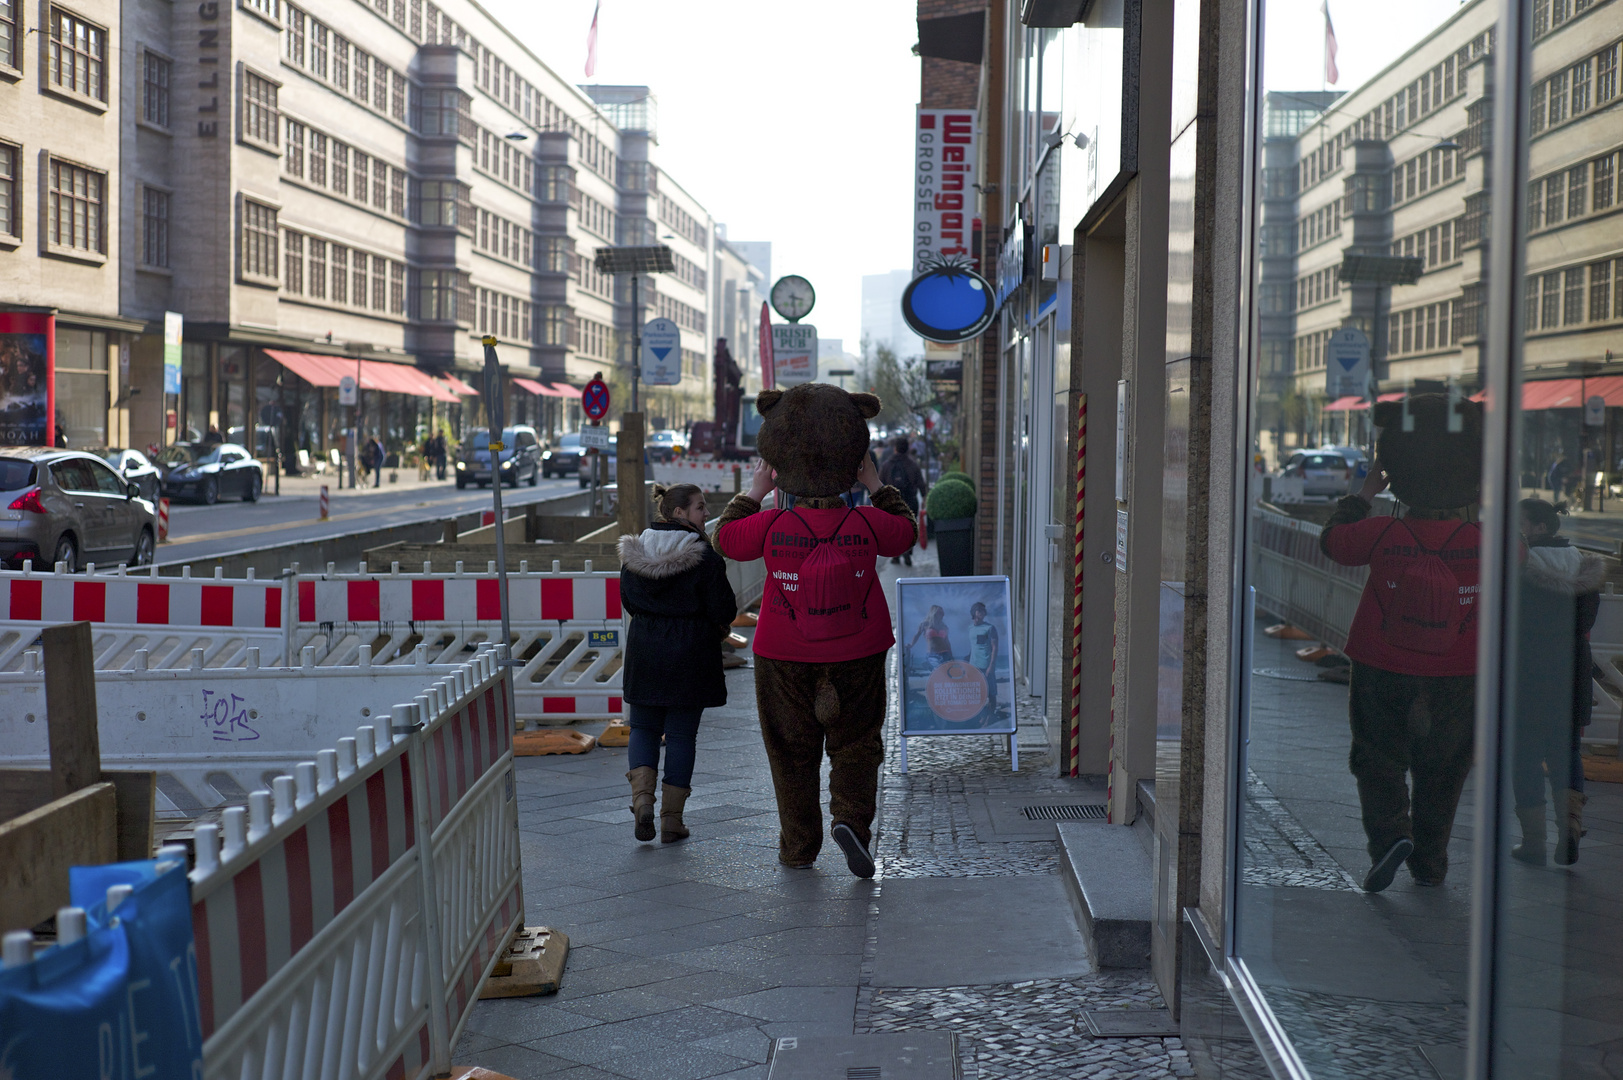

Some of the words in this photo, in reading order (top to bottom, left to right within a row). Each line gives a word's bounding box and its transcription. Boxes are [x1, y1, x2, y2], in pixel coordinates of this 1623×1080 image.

[198, 2, 218, 137] ELLING
[917, 132, 934, 212] GROSSE
[656, 323, 666, 331] 12
[774, 328, 812, 338] IRISH
[780, 339, 806, 348] PUB
[808, 603, 851, 616] Weingarten
